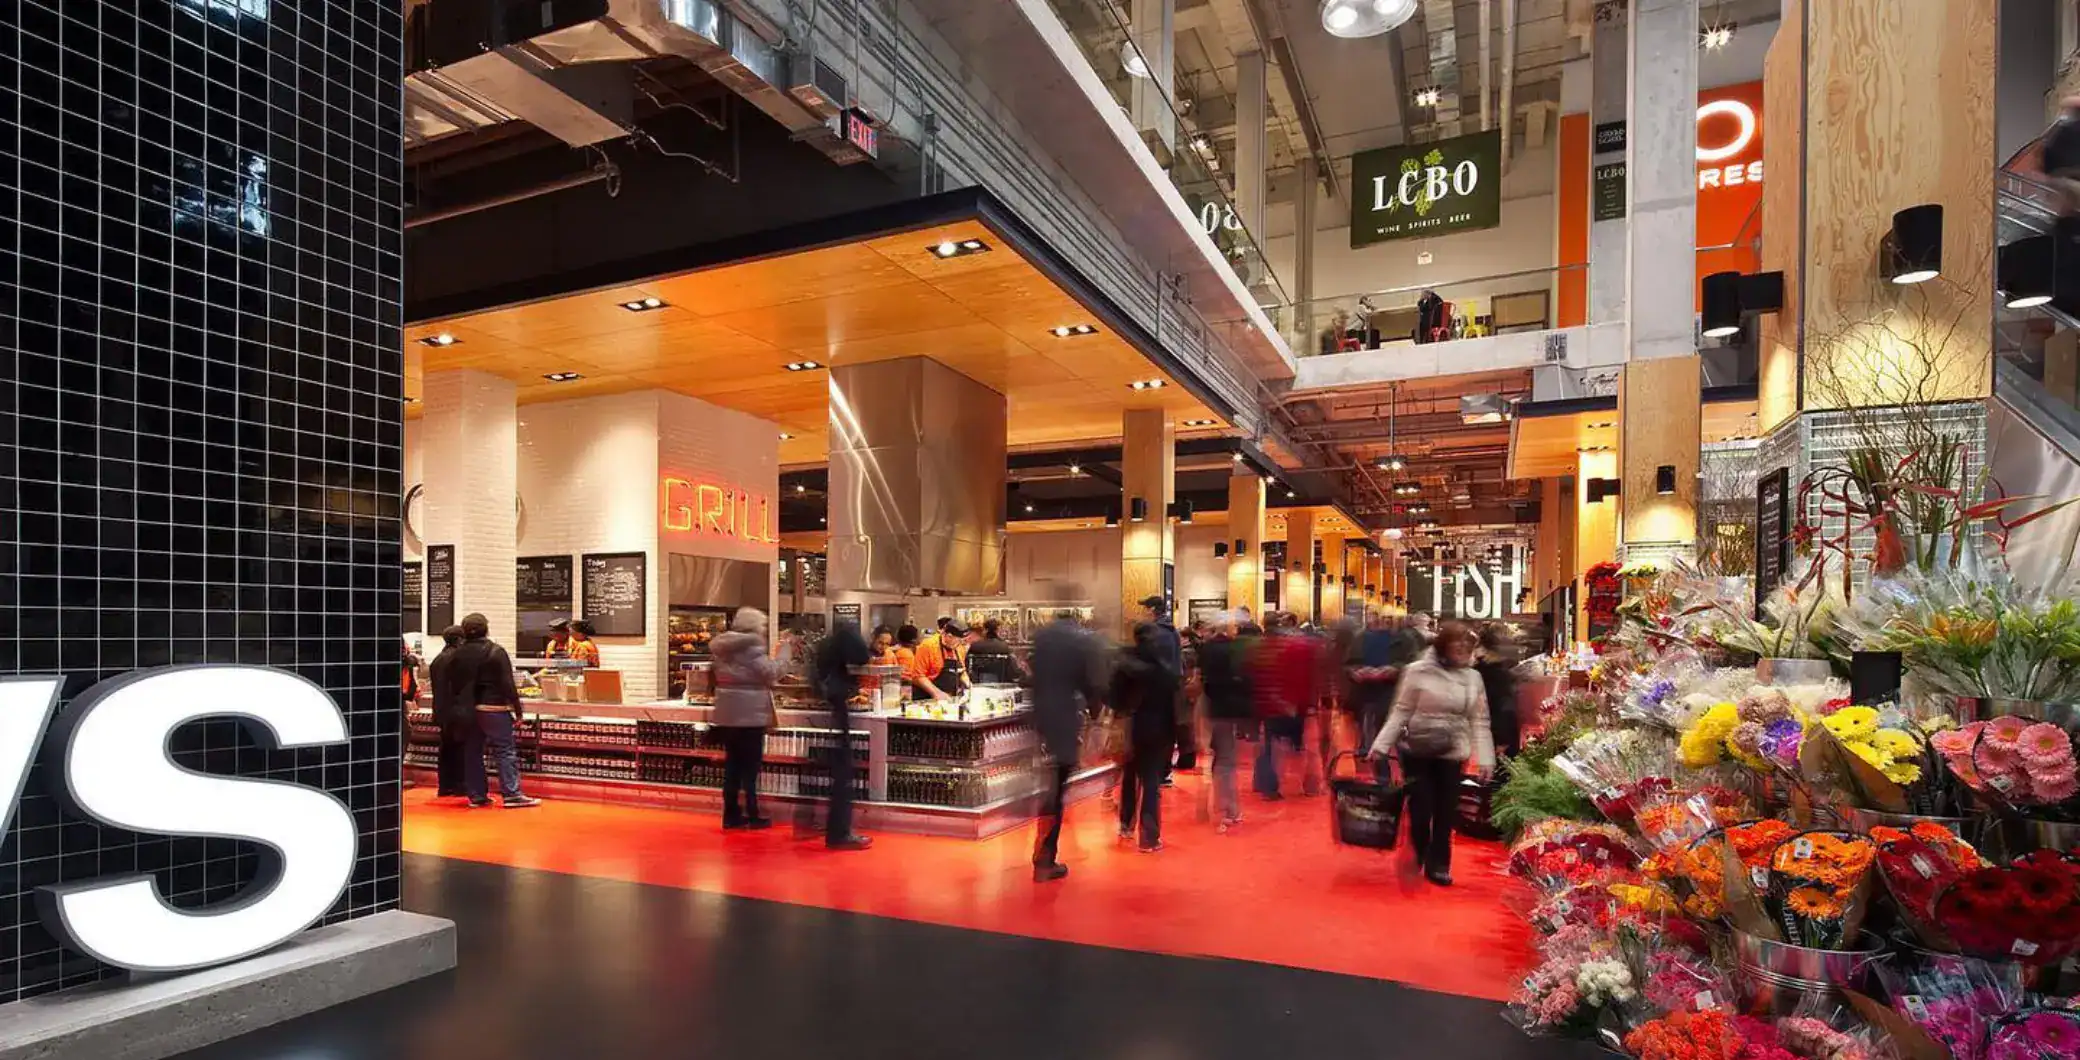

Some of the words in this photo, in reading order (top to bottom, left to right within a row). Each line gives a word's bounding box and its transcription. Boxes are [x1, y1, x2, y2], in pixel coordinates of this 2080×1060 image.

[850, 114, 873, 154] EXIT
[1371, 159, 1479, 212] LCBO
[1376, 223, 1402, 235] WINE
[1407, 216, 1442, 231] SPIRITS
[1449, 212, 1472, 225] BEER
[663, 477, 780, 543] GRILL
[1432, 543, 1522, 619] FISH
